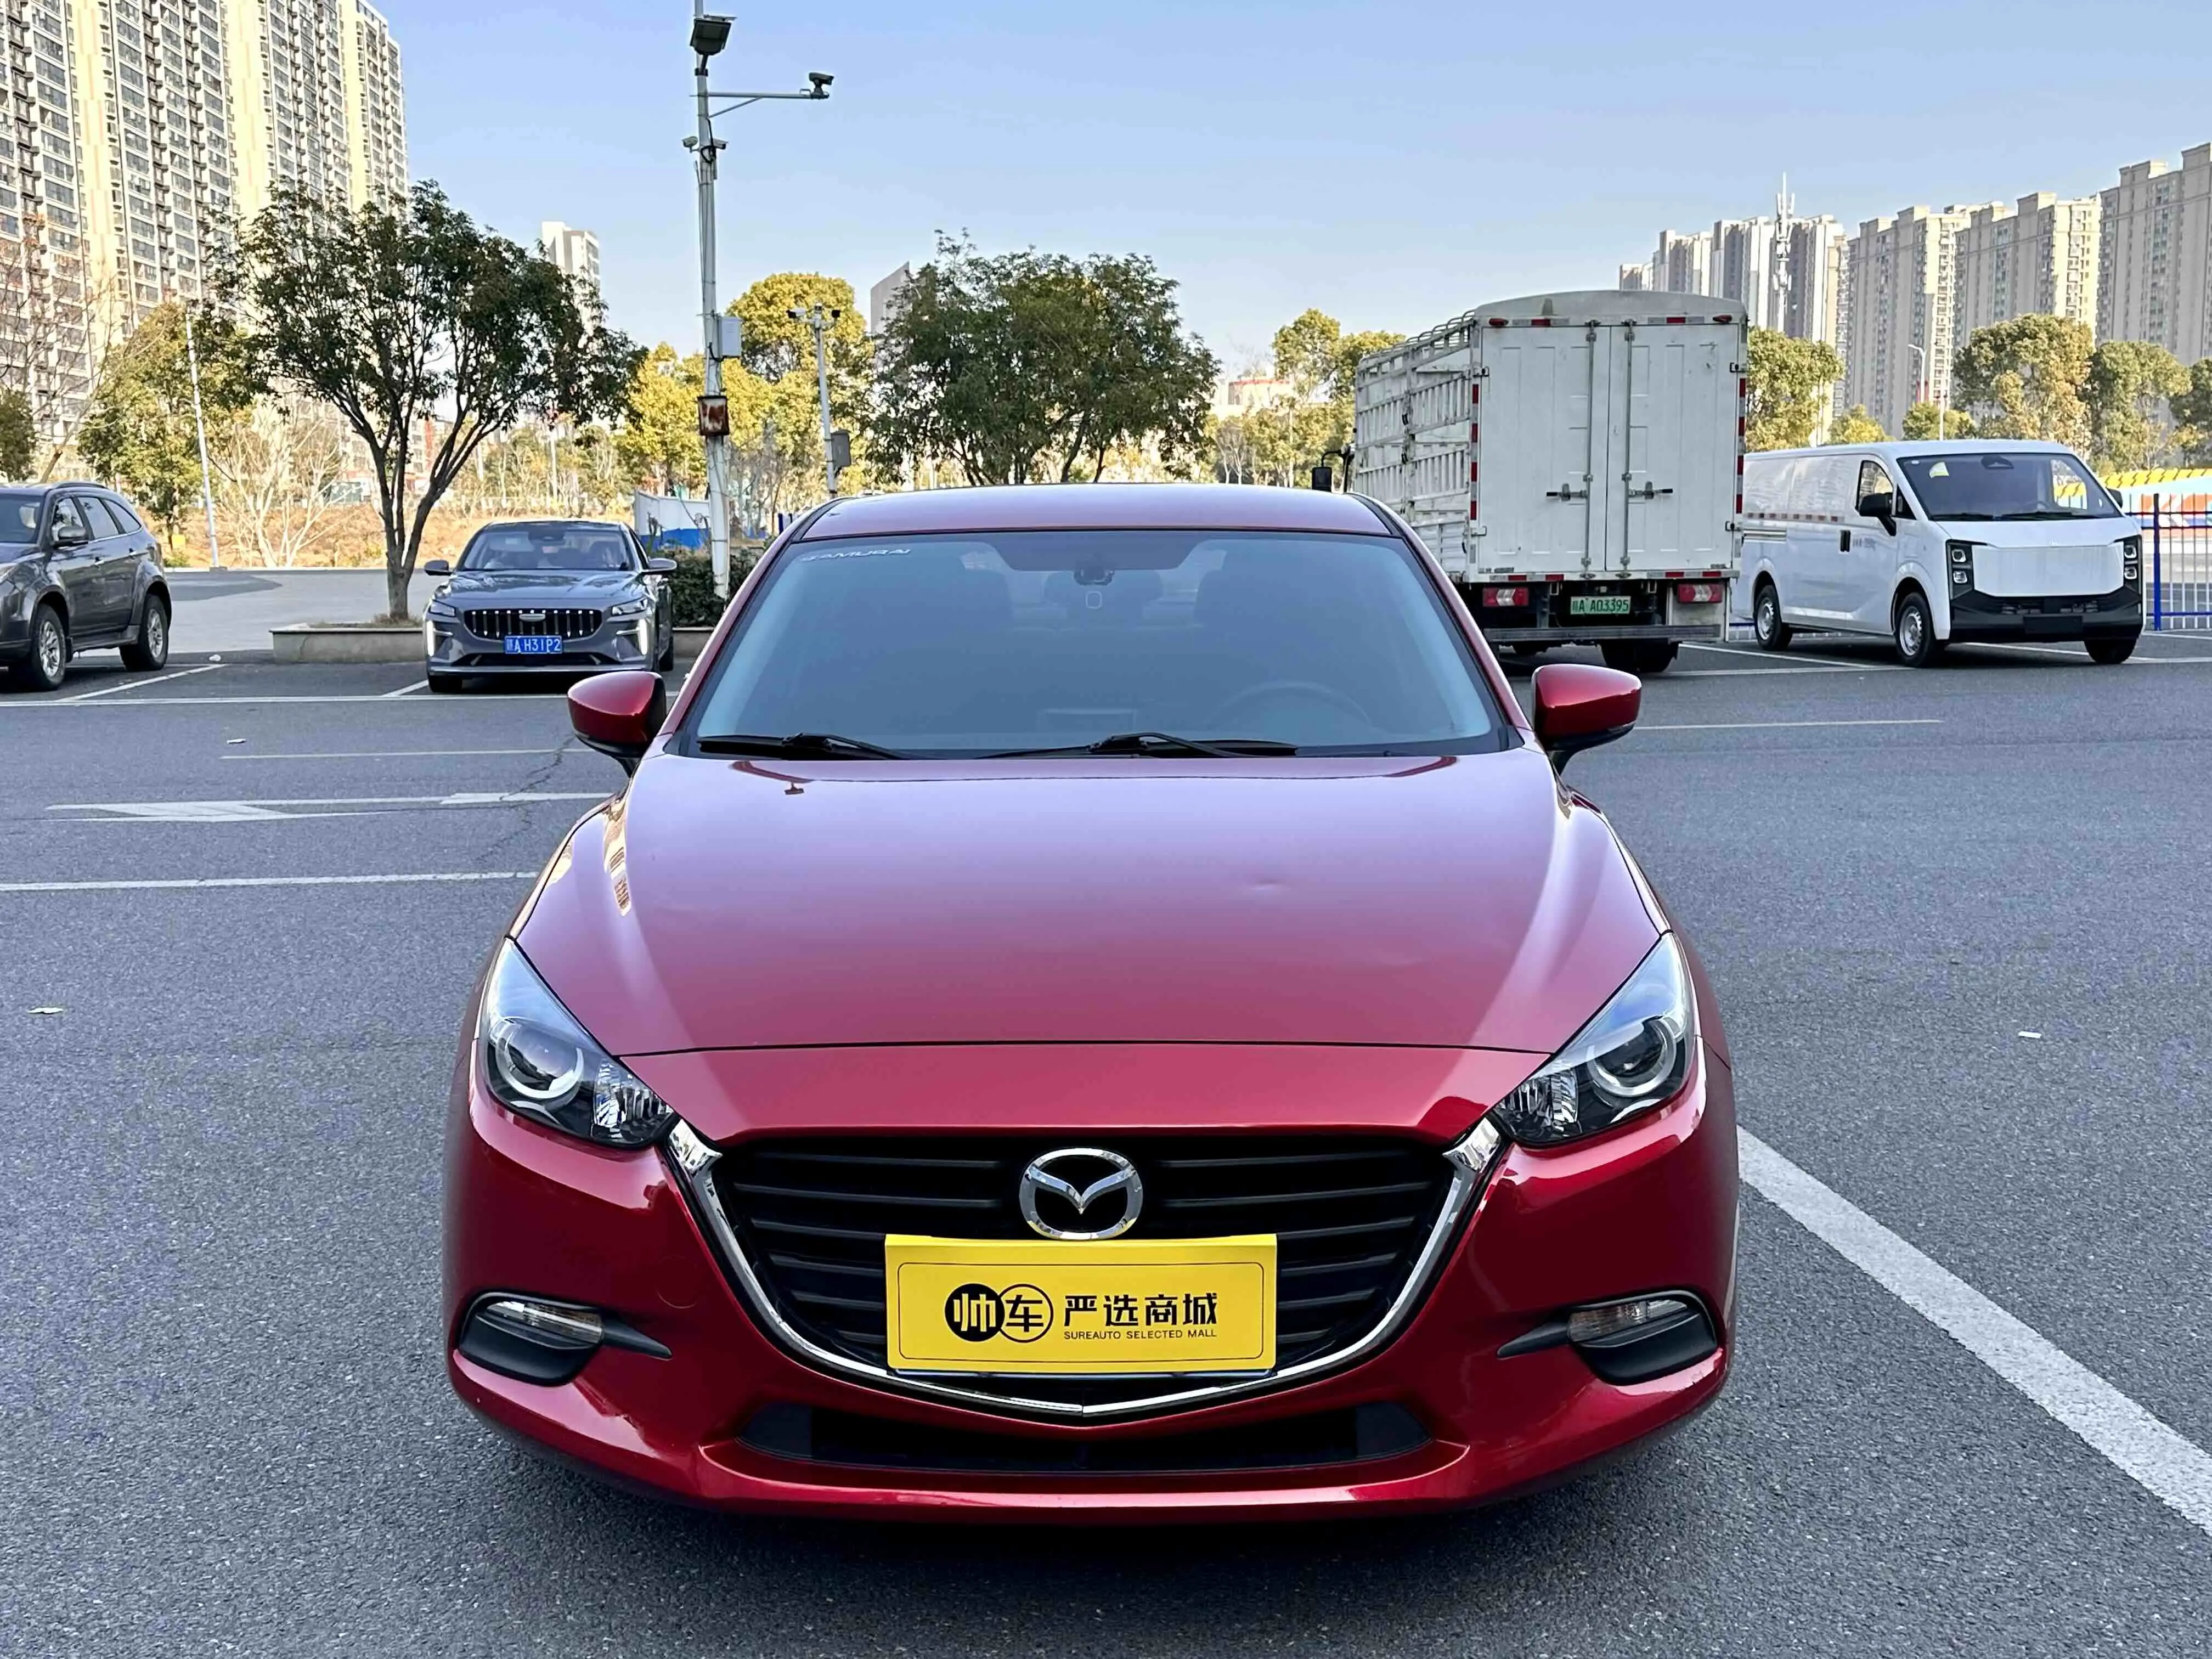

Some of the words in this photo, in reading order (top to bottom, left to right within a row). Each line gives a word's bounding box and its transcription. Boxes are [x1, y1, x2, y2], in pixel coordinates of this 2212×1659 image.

[952, 1292, 1045, 1334] 帅车
[1064, 1293, 1217, 1327] 严选商城
[1064, 1330, 1121, 1340] SUREAUTO
[1126, 1330, 1183, 1339] SELECTED
[1187, 1329, 1217, 1338] MALL
